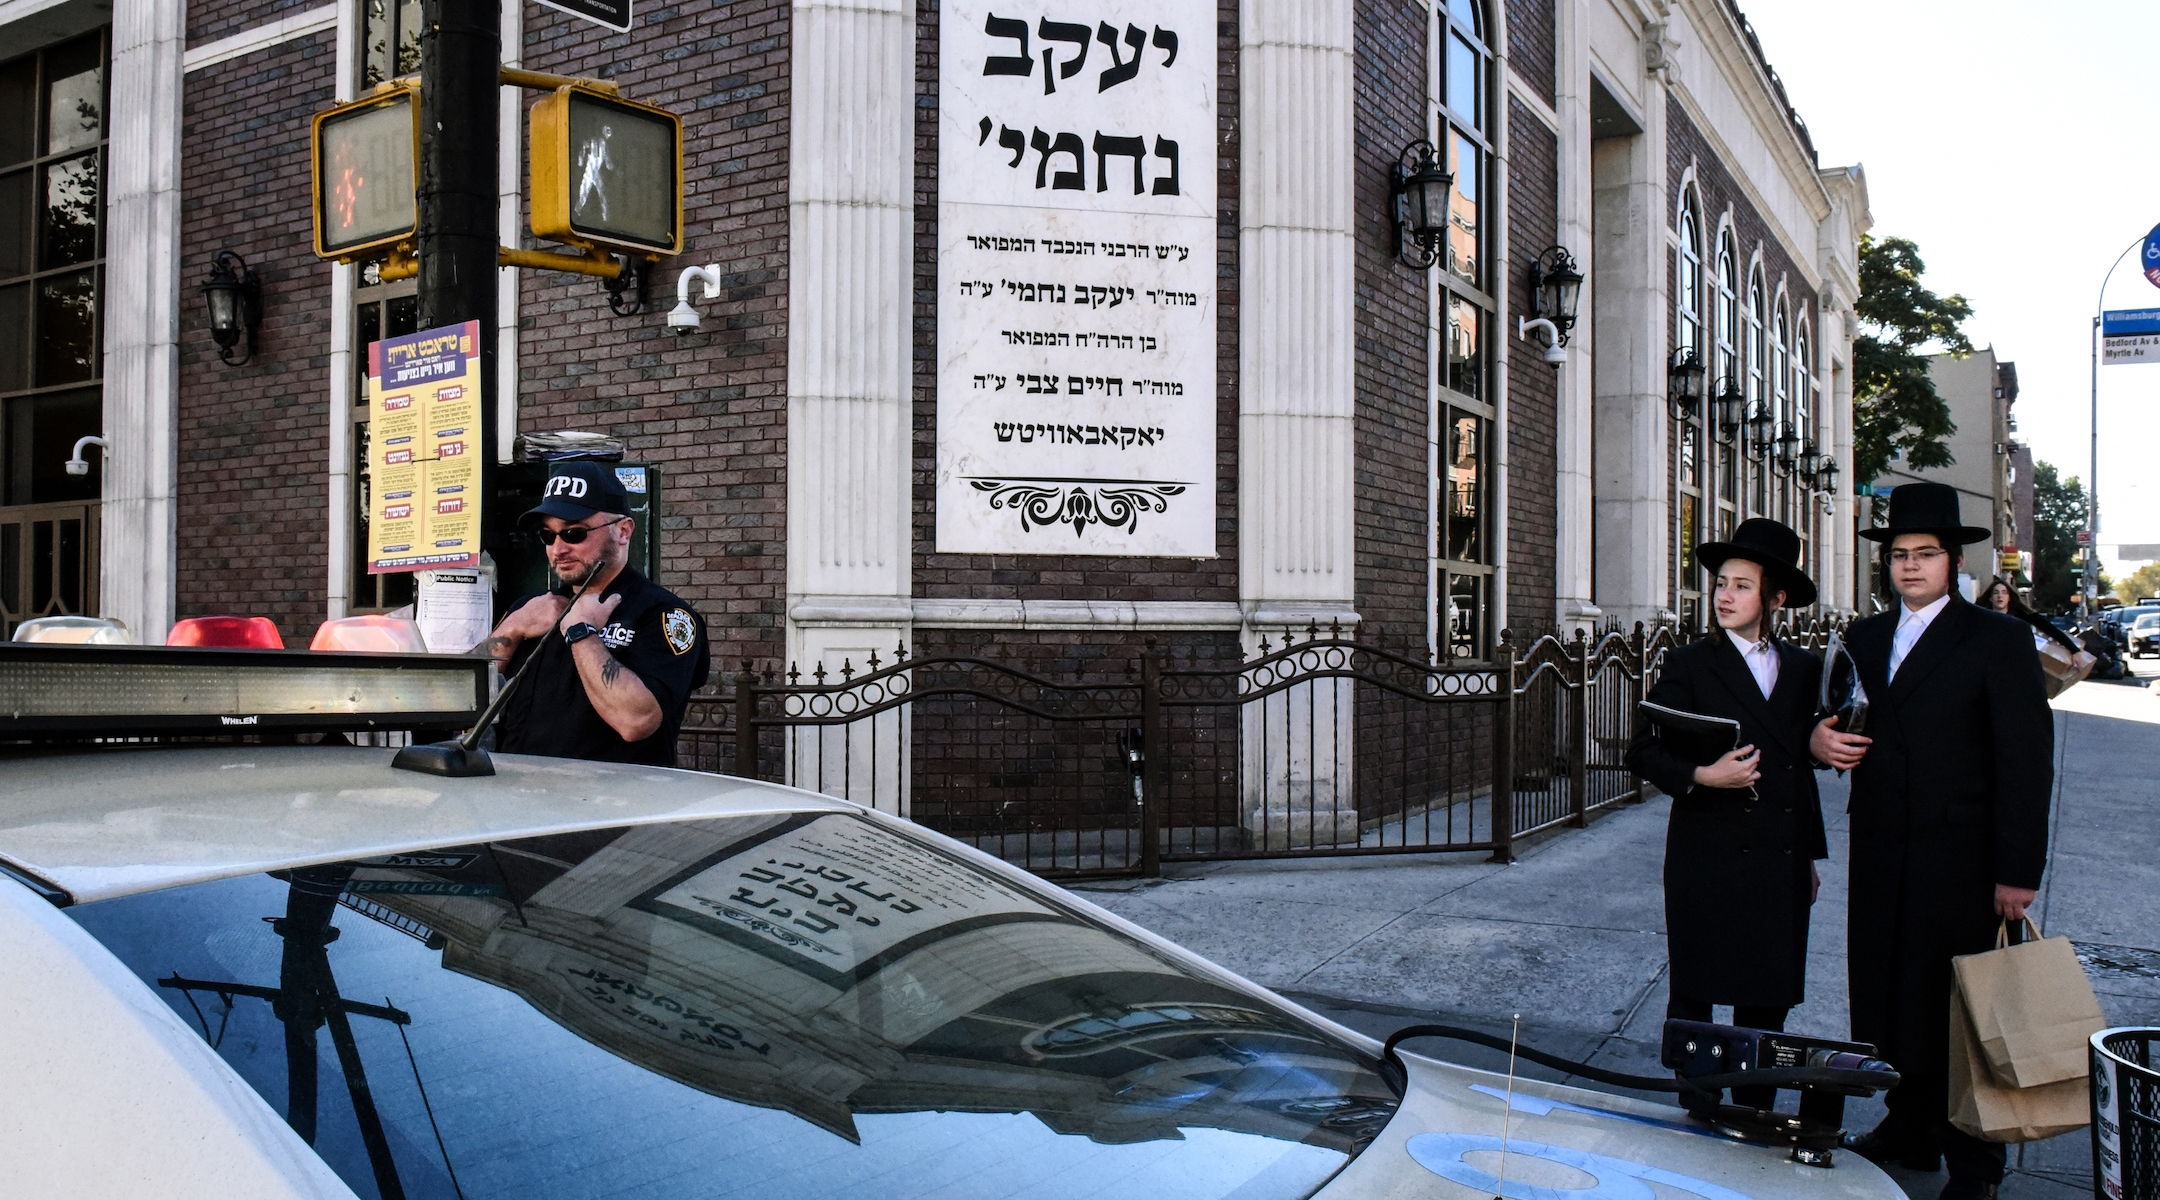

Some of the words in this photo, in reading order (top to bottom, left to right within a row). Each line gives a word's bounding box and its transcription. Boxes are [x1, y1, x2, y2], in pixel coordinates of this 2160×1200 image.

[983, 12, 1178, 96] יעקב
[979, 115, 1180, 196] נחמי׳
[967, 235, 1035, 253] המפואר
[1041, 239, 1095, 255] הנכבד
[1101, 242, 1149, 258] הרבני
[1074, 284, 1135, 310] יעקב
[2106, 311, 2160, 322] Williamsburg
[1001, 330, 1069, 347] המפואר
[1139, 336, 1157, 353] בן
[2105, 338, 2137, 347] Bedford
[2140, 337, 2150, 345] Av
[2153, 337, 2159, 345] &
[2105, 349, 2131, 359] Myrtle
[2134, 348, 2144, 356] Av
[1016, 373, 1060, 395] צבי
[1068, 375, 1123, 397] חיים
[993, 422, 1164, 450] יאקאבאוויטש
[456, 575, 475, 583] Notice
[598, 627, 635, 643] OLICE
[220, 715, 258, 725] WHELEN
